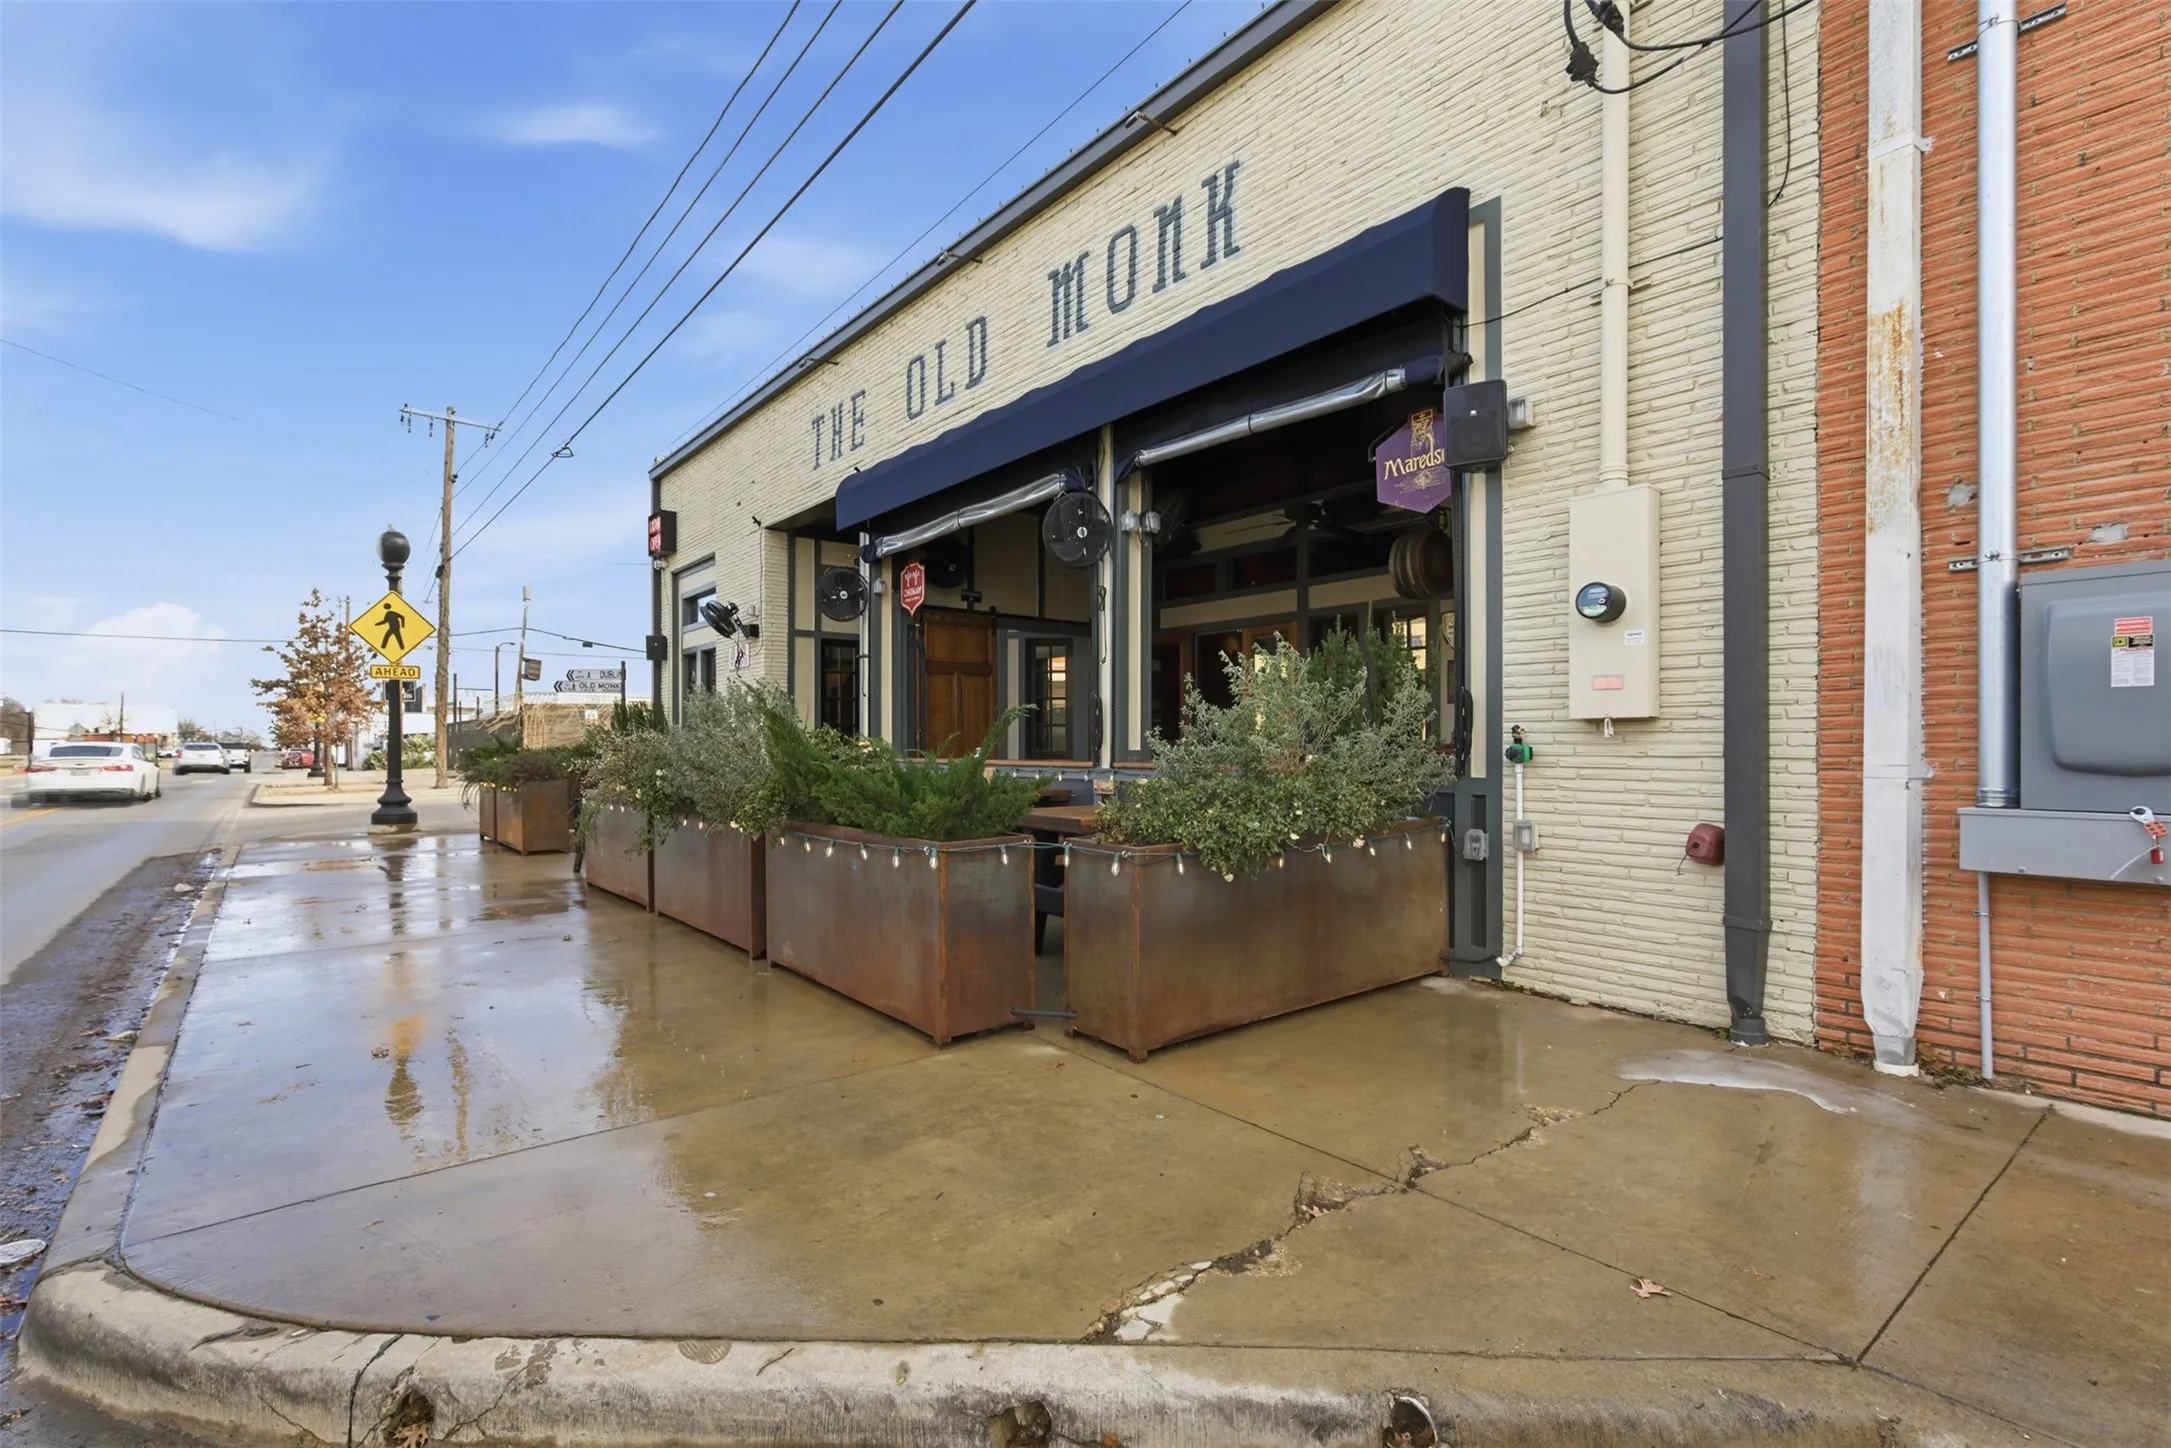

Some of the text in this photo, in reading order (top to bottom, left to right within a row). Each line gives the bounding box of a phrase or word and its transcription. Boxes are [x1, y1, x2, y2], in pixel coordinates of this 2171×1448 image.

[812, 159, 1241, 471] THE OLD MONK
[375, 667, 416, 677] AHEAD
[579, 682, 595, 690] OLD
